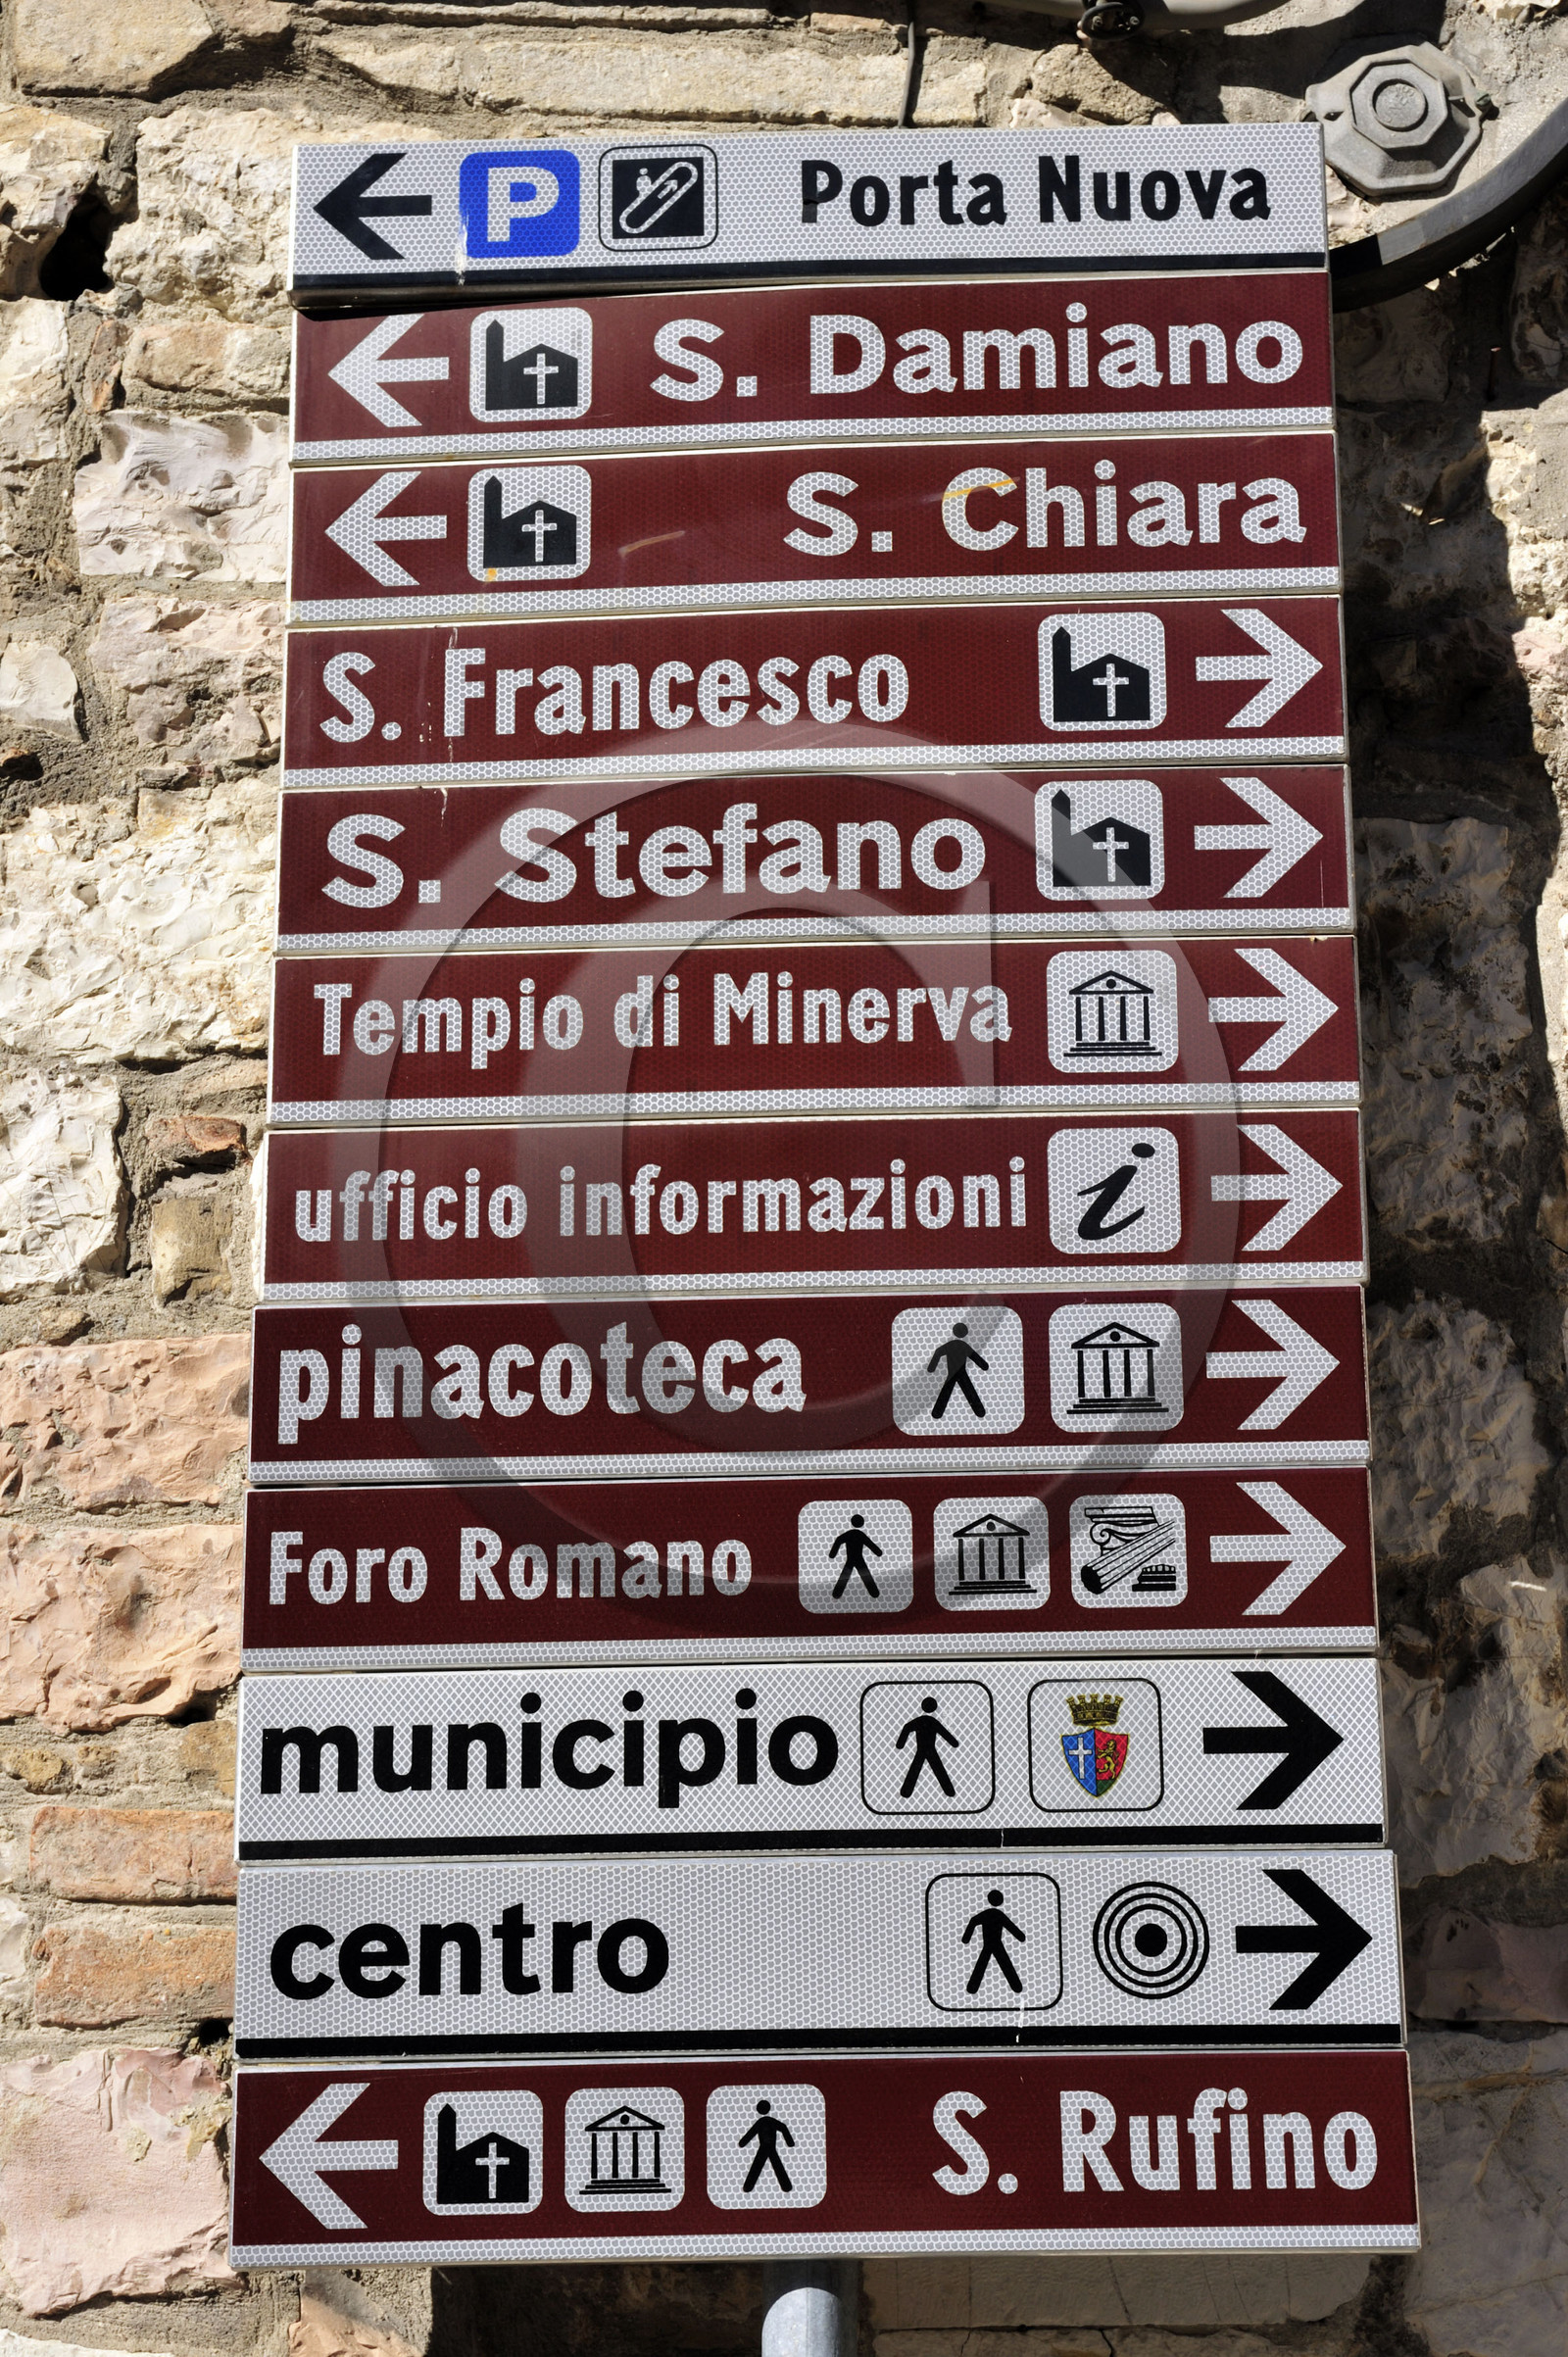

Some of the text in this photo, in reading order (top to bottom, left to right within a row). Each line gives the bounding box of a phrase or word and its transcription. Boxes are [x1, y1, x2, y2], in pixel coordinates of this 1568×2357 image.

[485, 166, 561, 242] P
[802, 153, 1271, 226] Porta Nuova
[649, 302, 1303, 404] S. Damiano
[782, 457, 1306, 559] S. Chiara
[318, 647, 909, 745] S. Francesco
[321, 800, 986, 911] S. Stefano
[312, 970, 1013, 1070] Tempio di Minerva
[294, 1156, 1027, 1243] ufficio informazioni
[1077, 1142, 1156, 1242] i
[277, 1320, 807, 1445] pinacoteca
[268, 1526, 753, 1605] Foro Romano
[259, 1688, 840, 1809] municipio
[269, 1901, 670, 2001] centro
[931, 2087, 1378, 2197] S. Rufino
